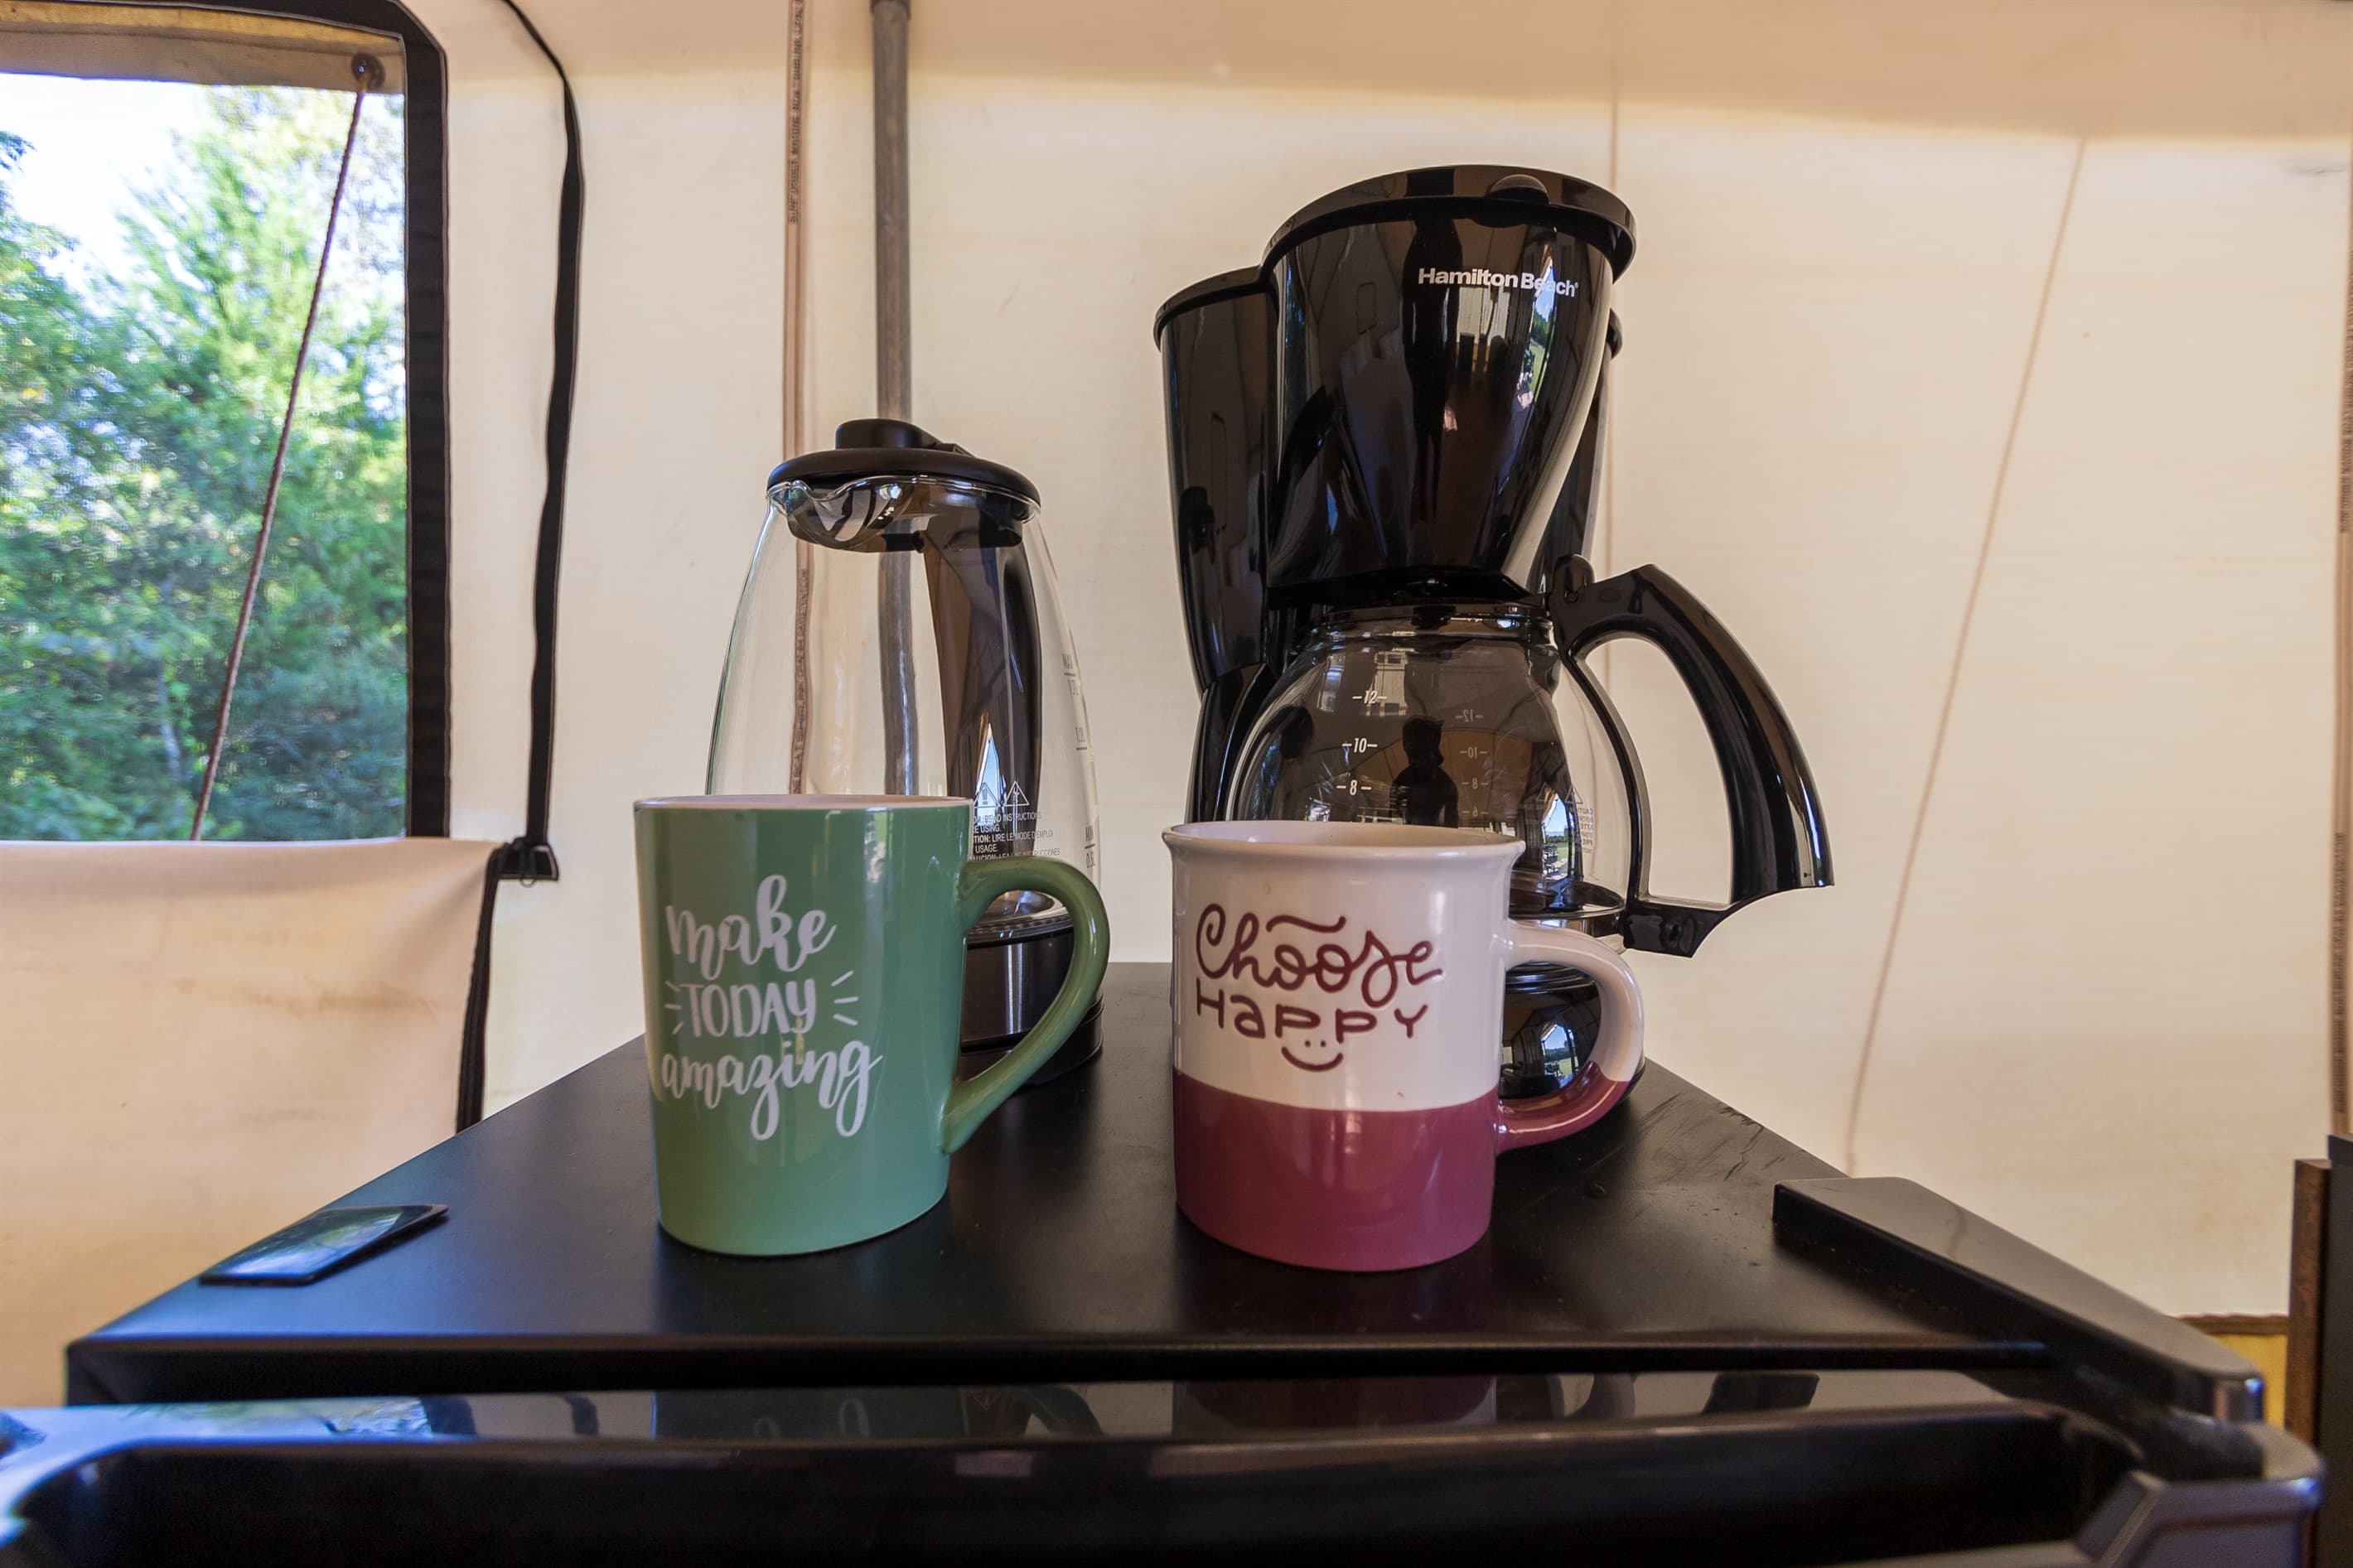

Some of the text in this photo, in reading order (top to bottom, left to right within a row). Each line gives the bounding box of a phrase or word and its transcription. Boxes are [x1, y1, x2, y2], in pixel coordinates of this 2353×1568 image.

[1418, 268, 1519, 288] Hamilton
[993, 833, 1005, 842] LIRE
[1007, 832, 1014, 842] LE
[665, 874, 837, 981] make
[1196, 903, 1443, 1008] Choose
[680, 978, 817, 1037] TODAY
[662, 1040, 883, 1141] amazing
